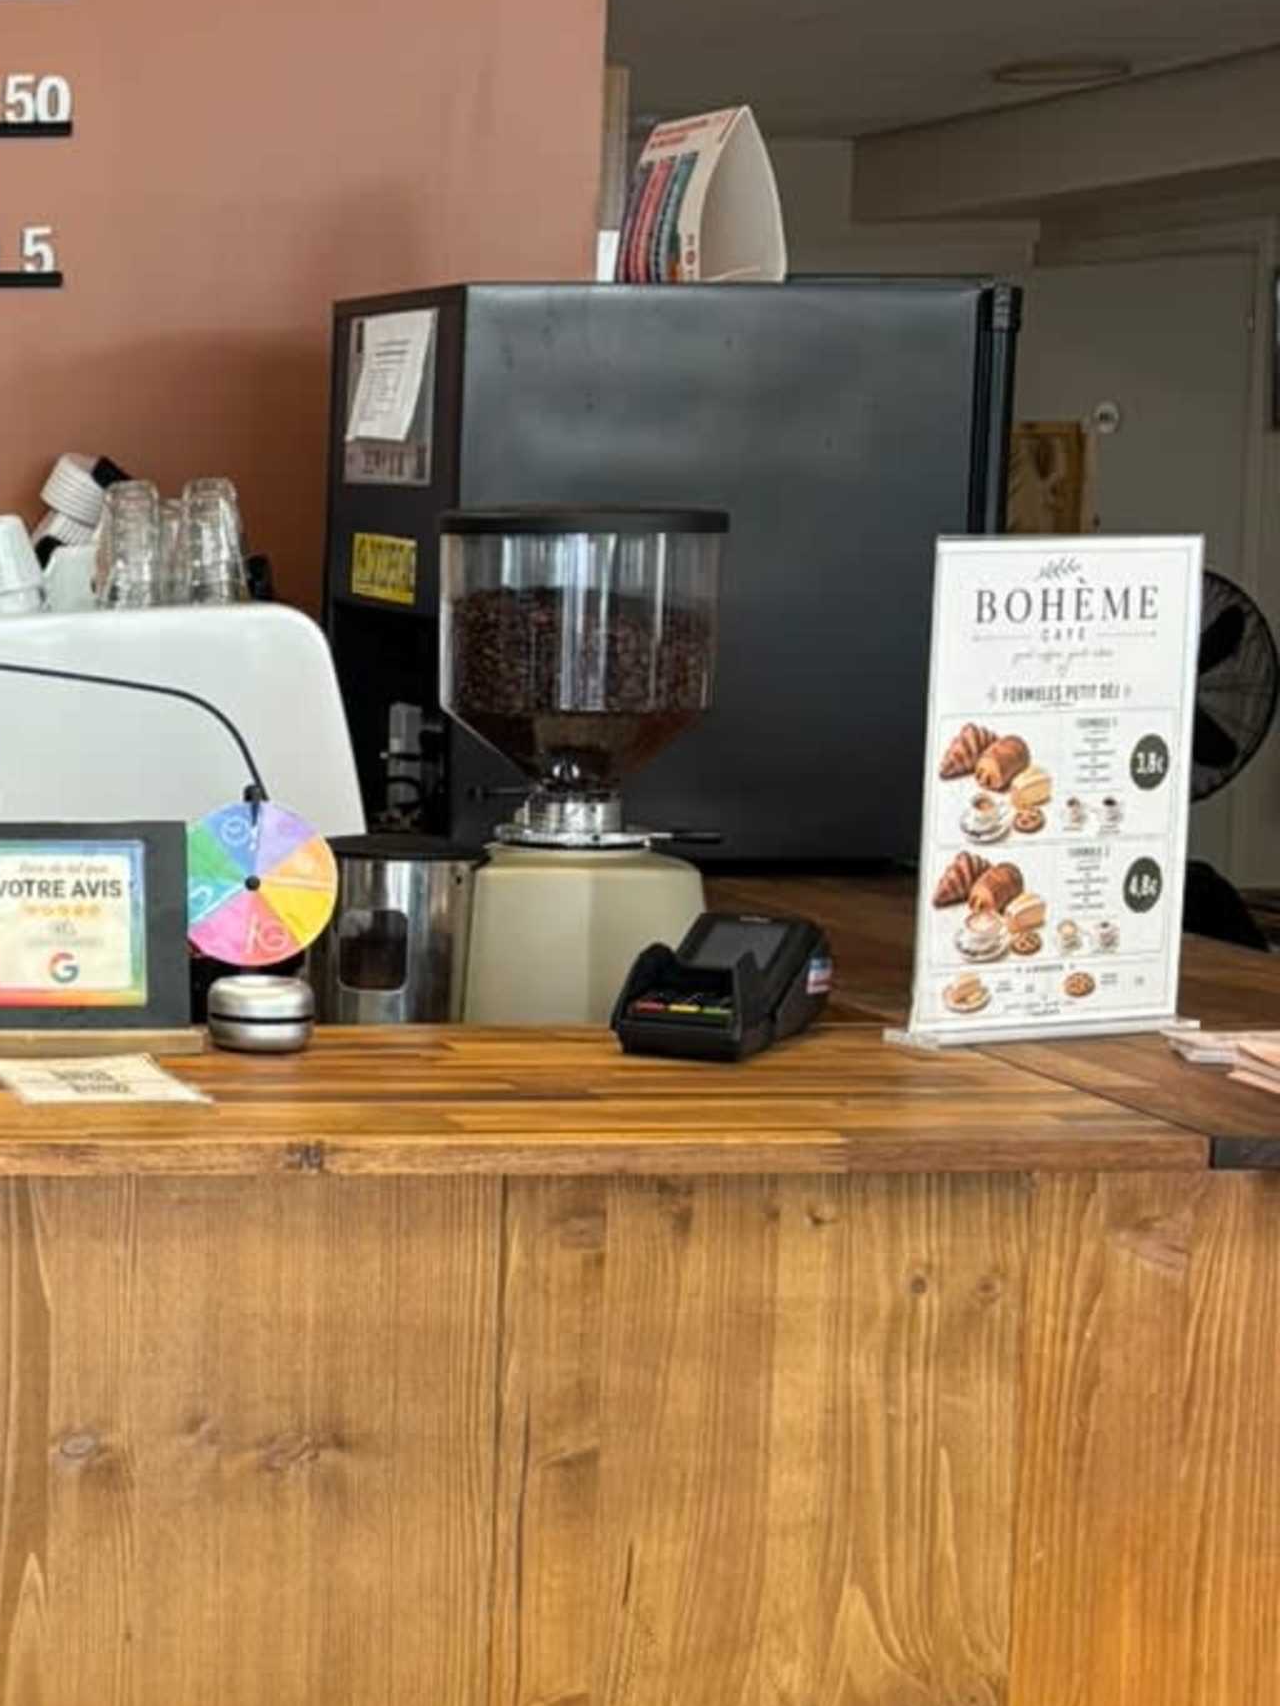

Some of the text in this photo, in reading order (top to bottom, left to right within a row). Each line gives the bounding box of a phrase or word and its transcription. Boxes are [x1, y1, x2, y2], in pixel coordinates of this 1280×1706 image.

[3, 74, 71, 124] 50
[19, 226, 54, 274] 5
[975, 576, 1159, 624] BOHÈME
[71, 878, 122, 898] AVIS
